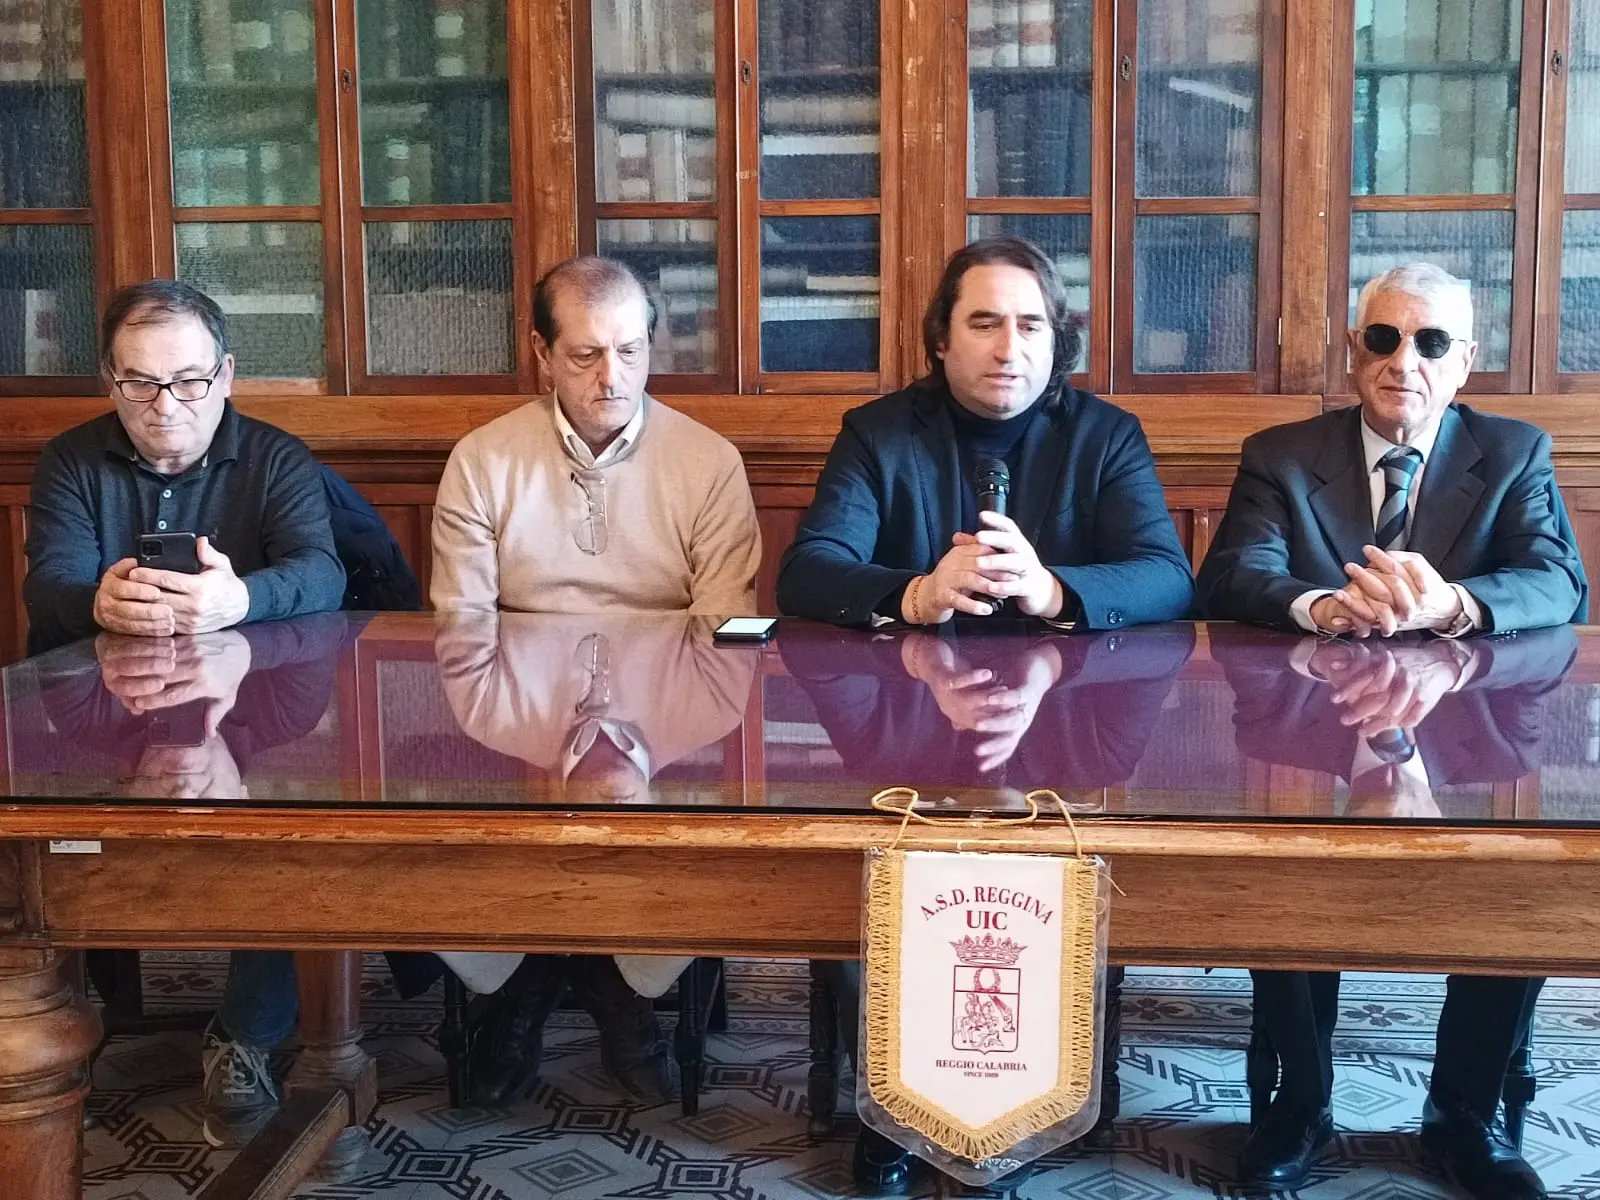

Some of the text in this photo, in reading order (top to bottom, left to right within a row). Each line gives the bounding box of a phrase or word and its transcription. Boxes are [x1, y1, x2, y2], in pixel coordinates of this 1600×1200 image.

[920, 886, 1053, 925] A.S.D. REGGINA
[966, 910, 1008, 930] UIC
[936, 1059, 1027, 1071] REGGIO CALABRIA
